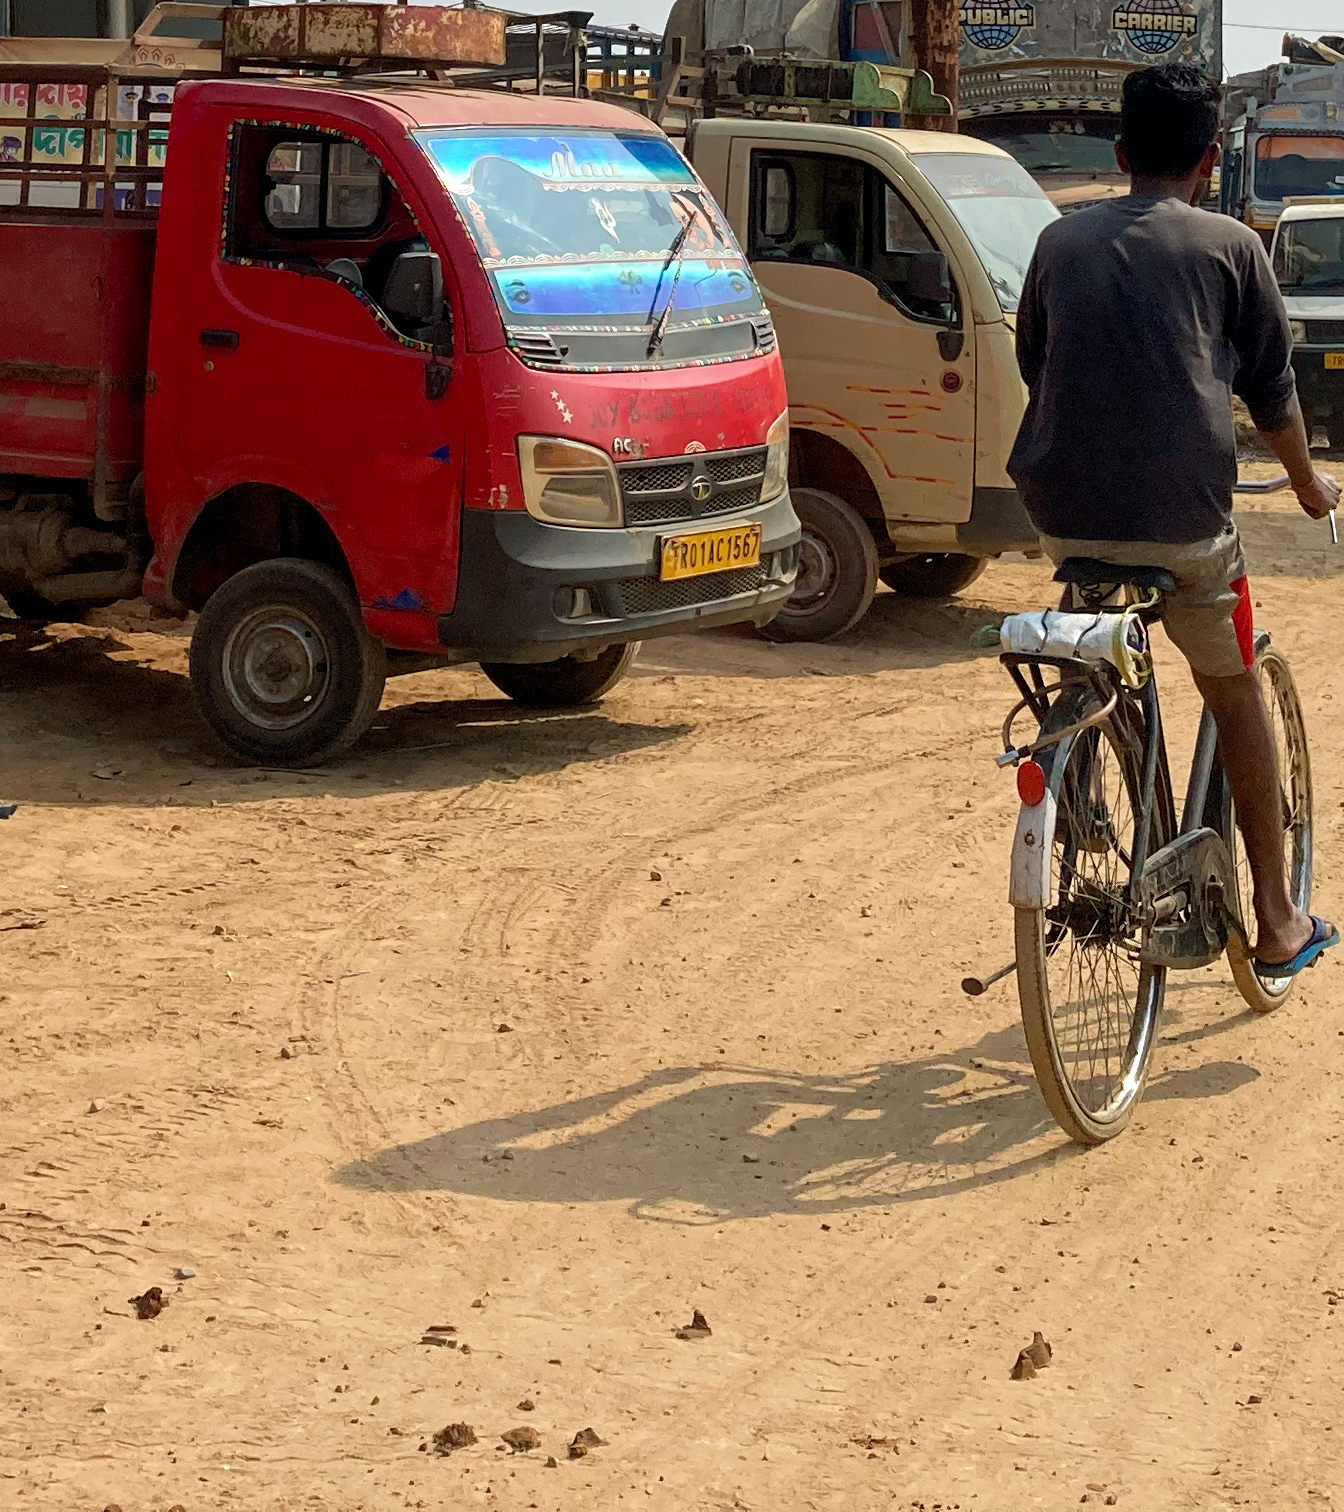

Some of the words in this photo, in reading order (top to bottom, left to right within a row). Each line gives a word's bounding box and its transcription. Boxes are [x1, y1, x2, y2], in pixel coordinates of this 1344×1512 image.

[958, 7, 1030, 26] PUBLIC
[1114, 12, 1197, 33] CARRIER
[543, 147, 623, 178] Maa
[669, 531, 760, 571] TR01AC1567
